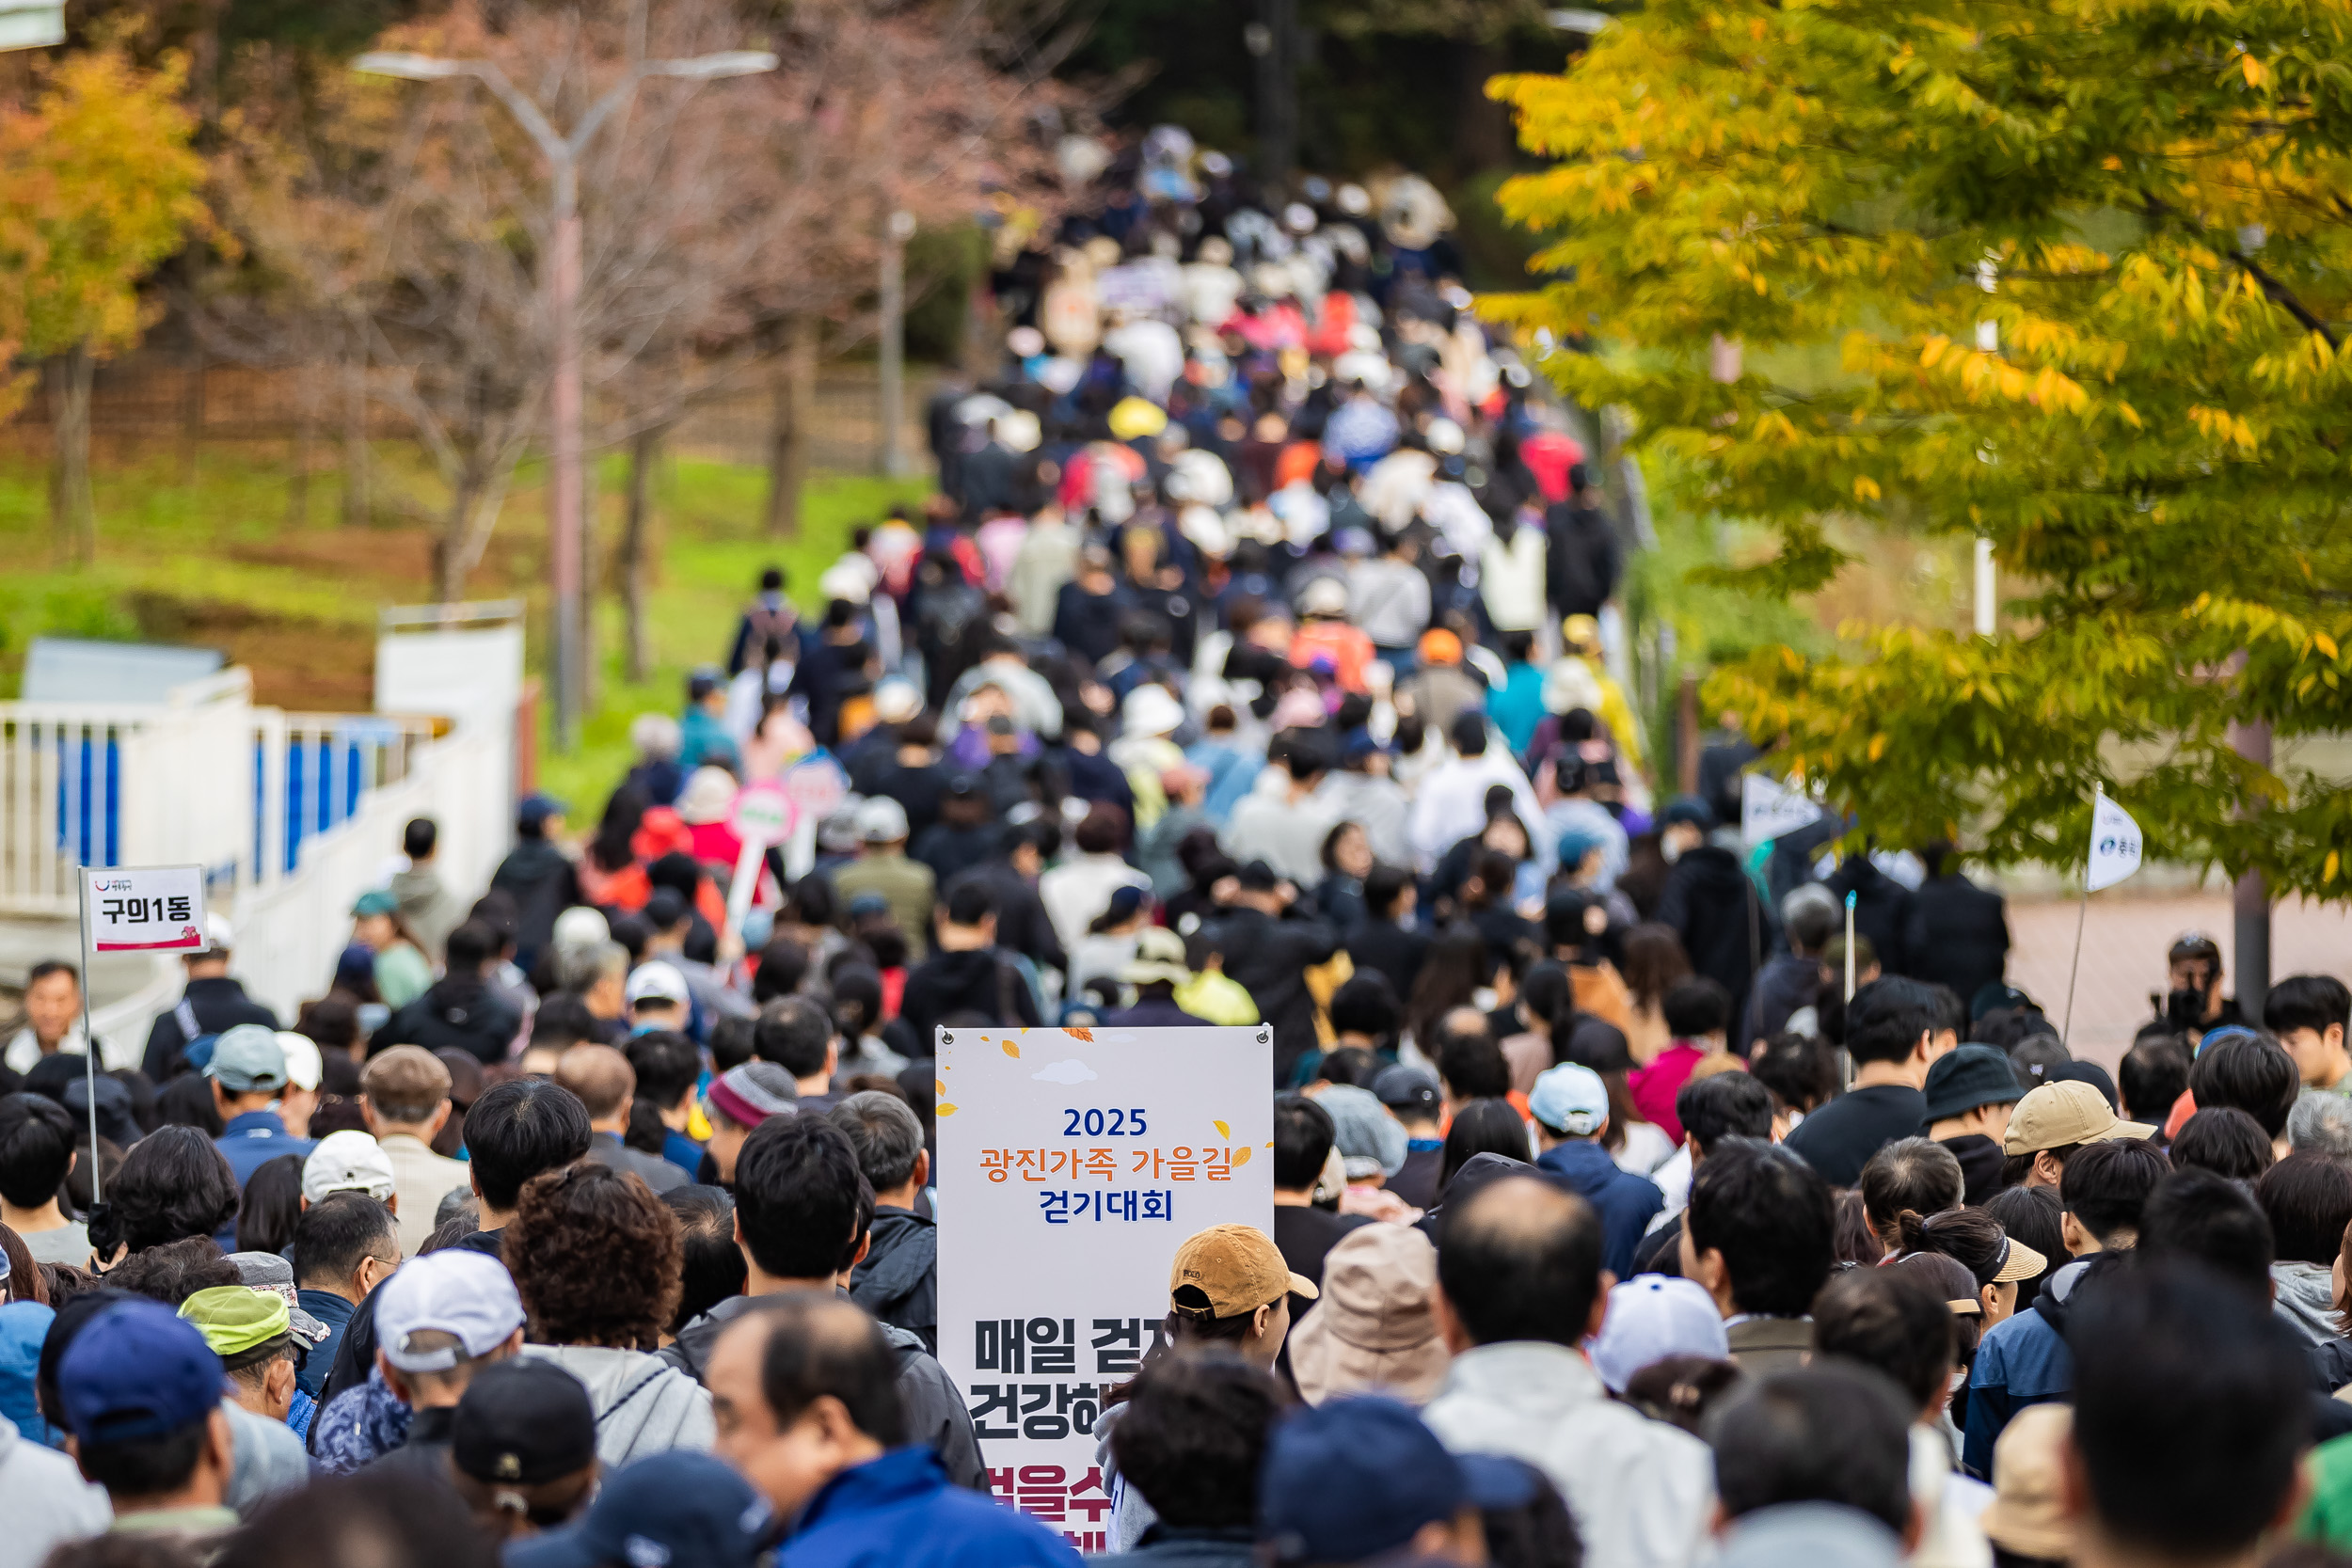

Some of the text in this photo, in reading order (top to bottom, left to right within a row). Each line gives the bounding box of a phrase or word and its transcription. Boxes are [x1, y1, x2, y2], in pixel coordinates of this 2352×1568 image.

[102, 895, 191, 924] 구의1동
[1063, 1108, 1148, 1137] 2025
[979, 1146, 1232, 1182] 광진가족 가을길
[1039, 1189, 1172, 1224] 걷기대회
[1183, 1269, 1200, 1279] POLO
[975, 1317, 1076, 1374] 매일
